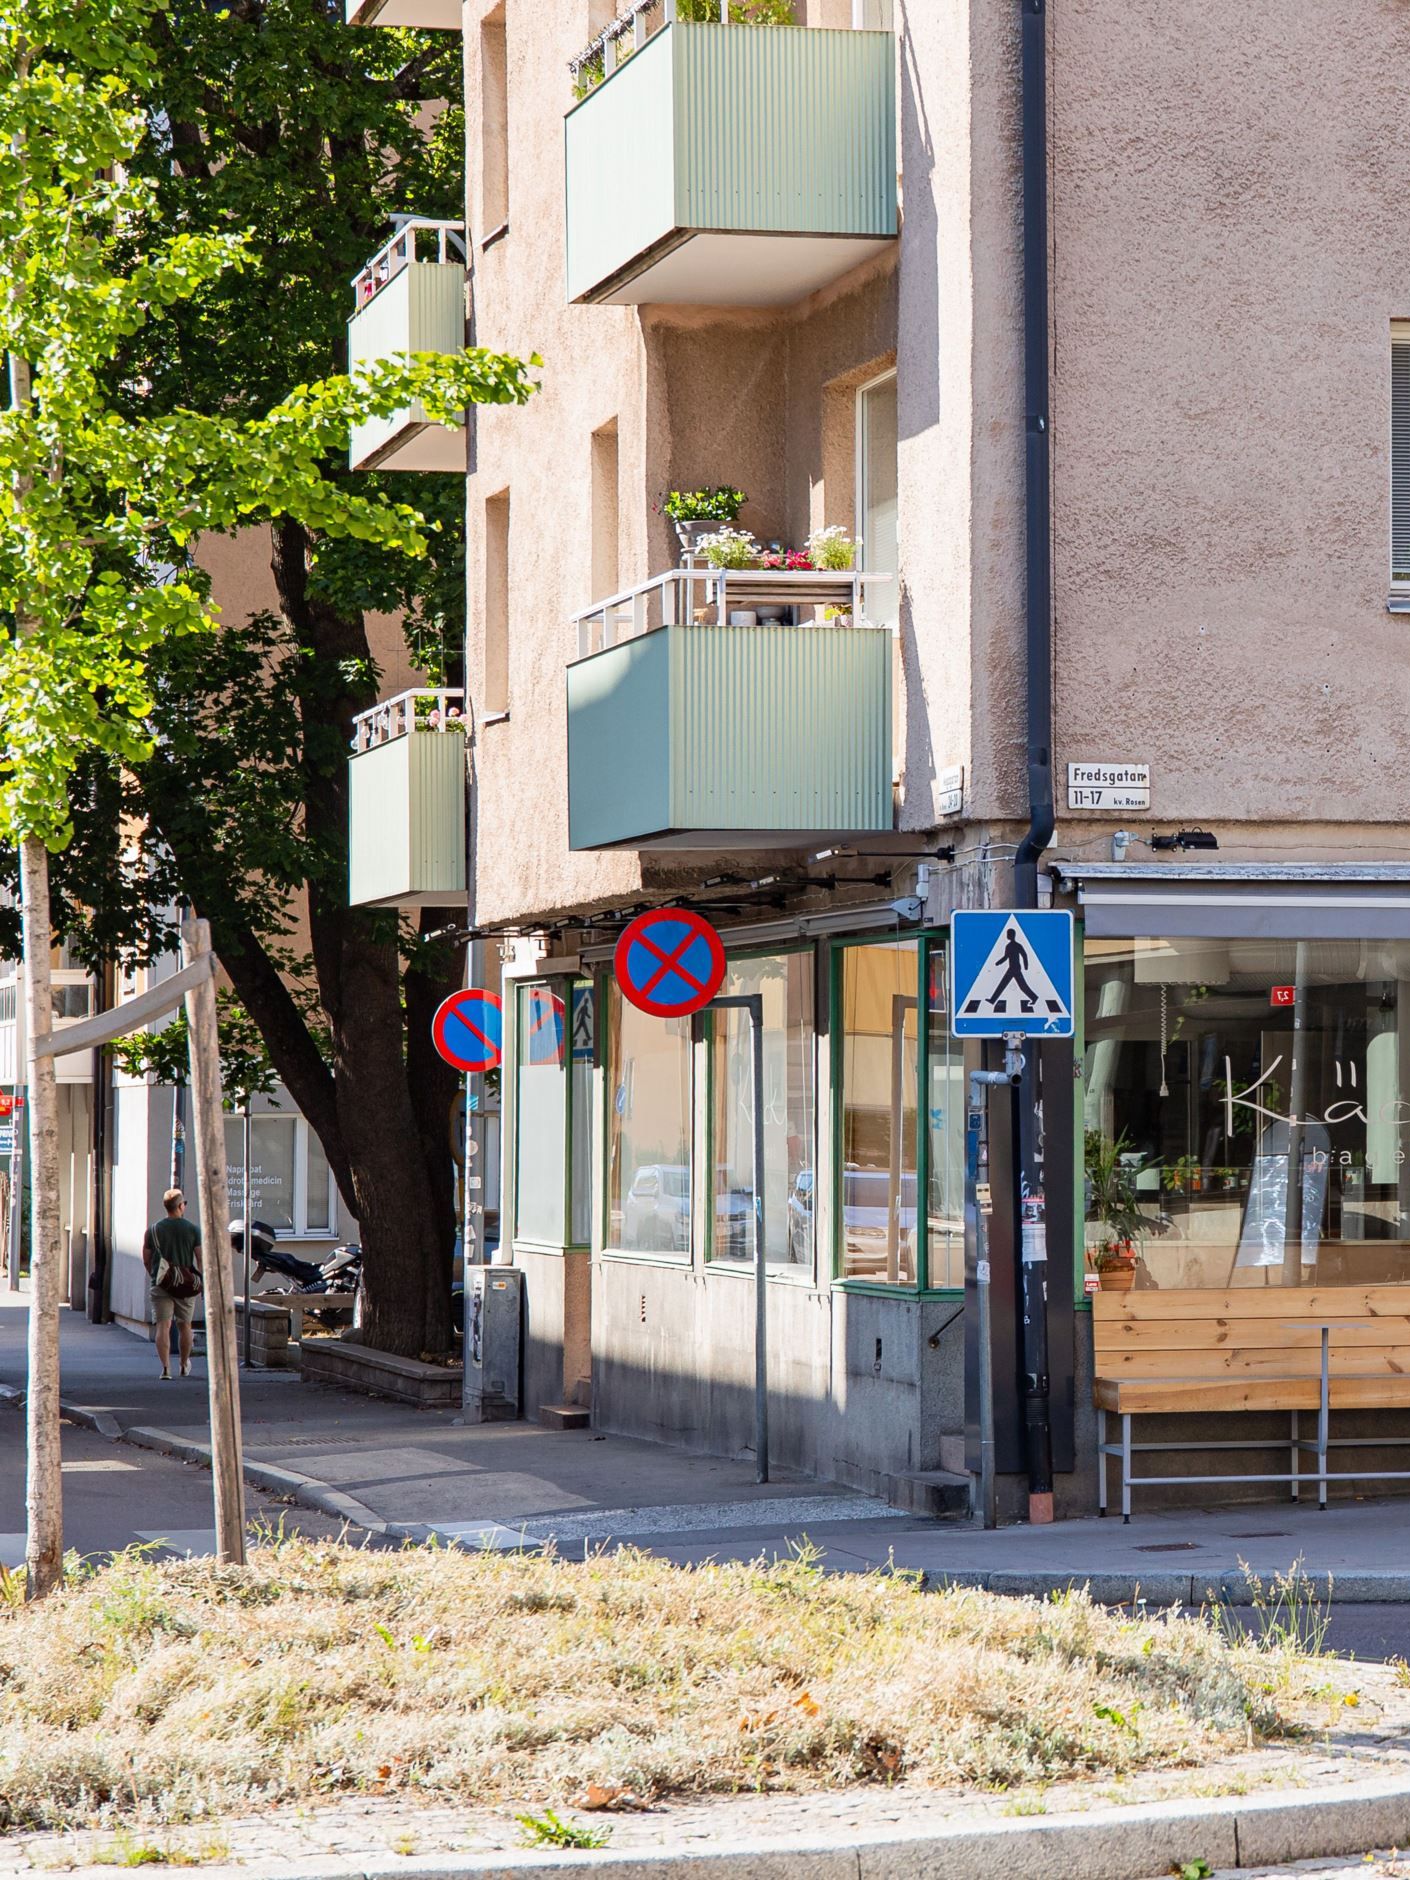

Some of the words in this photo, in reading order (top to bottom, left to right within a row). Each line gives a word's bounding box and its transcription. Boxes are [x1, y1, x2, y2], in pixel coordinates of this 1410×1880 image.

[1074, 768, 1144, 785] Fredsgatan
[1074, 790, 1103, 805] 11-17
[1125, 797, 1146, 806] Rosen
